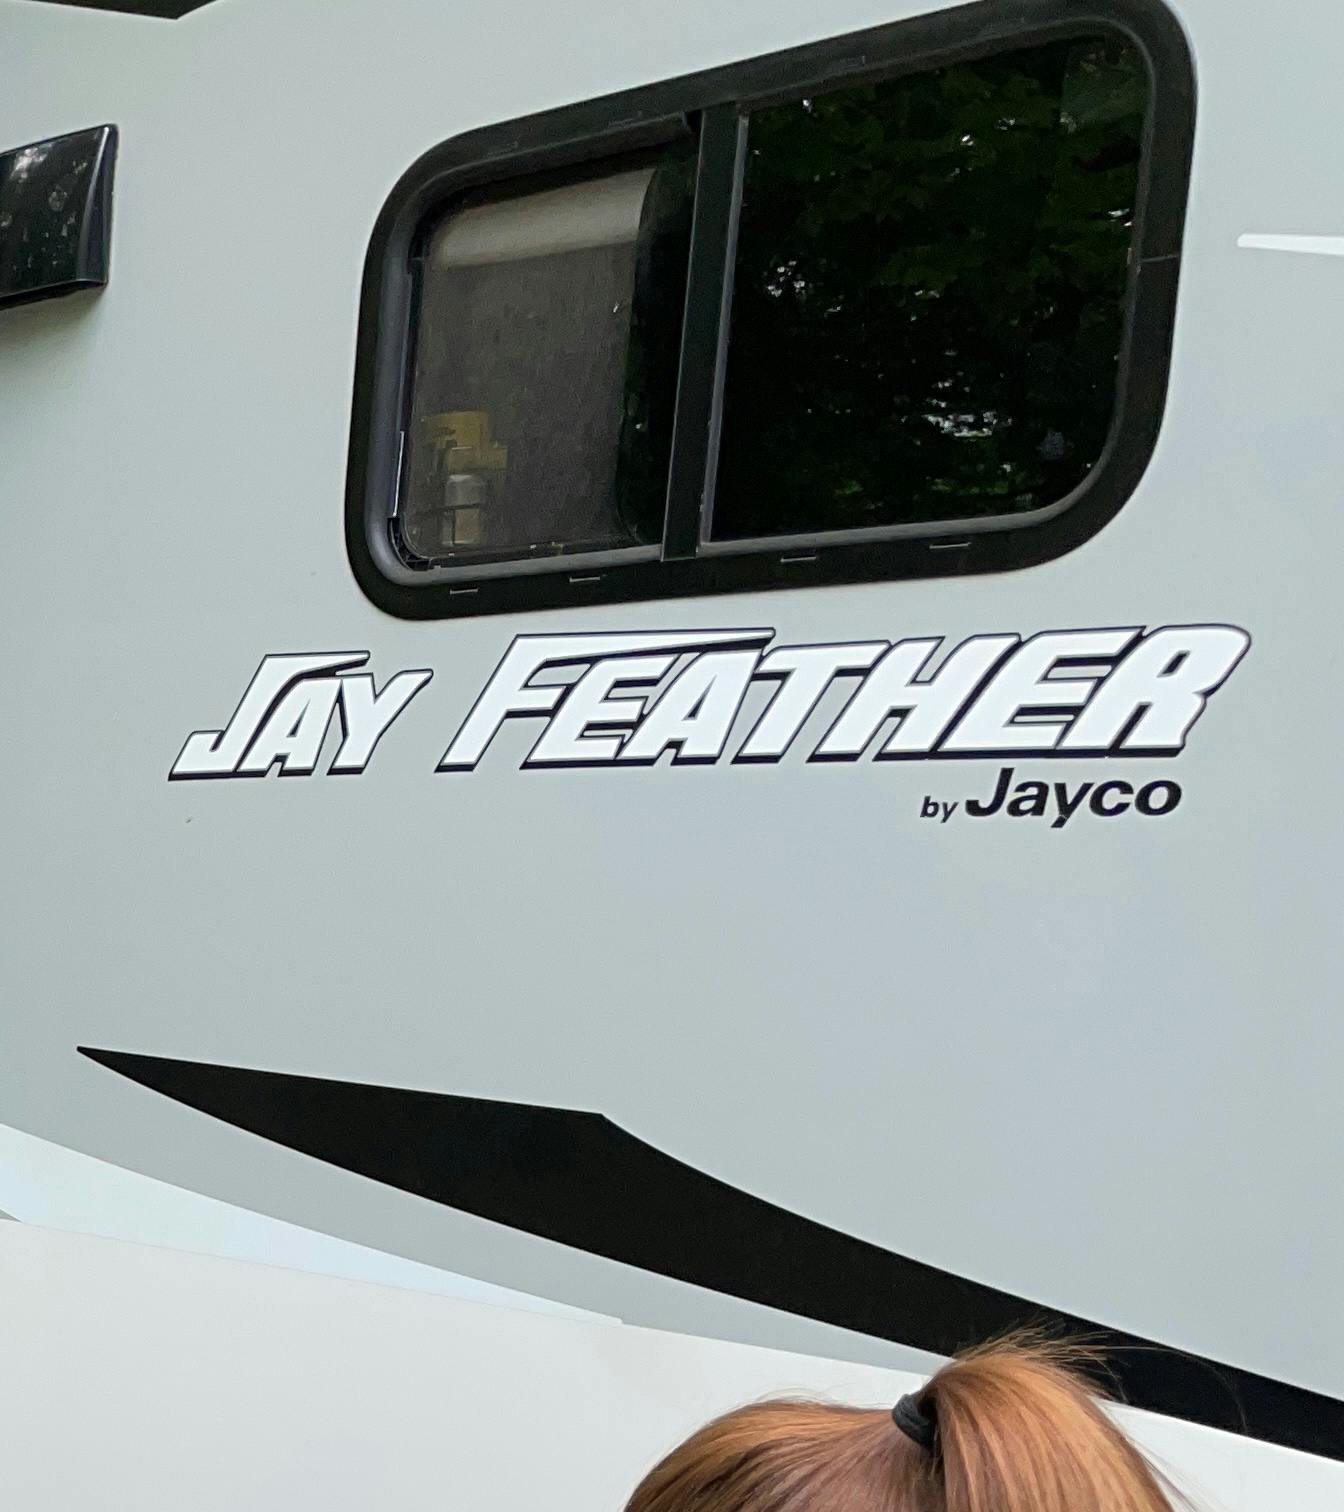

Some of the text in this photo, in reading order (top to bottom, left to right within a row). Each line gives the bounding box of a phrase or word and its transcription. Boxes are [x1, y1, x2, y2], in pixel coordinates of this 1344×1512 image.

[168, 623, 1253, 780] JAY FEATHER
[920, 767, 1182, 828] by Jayco
